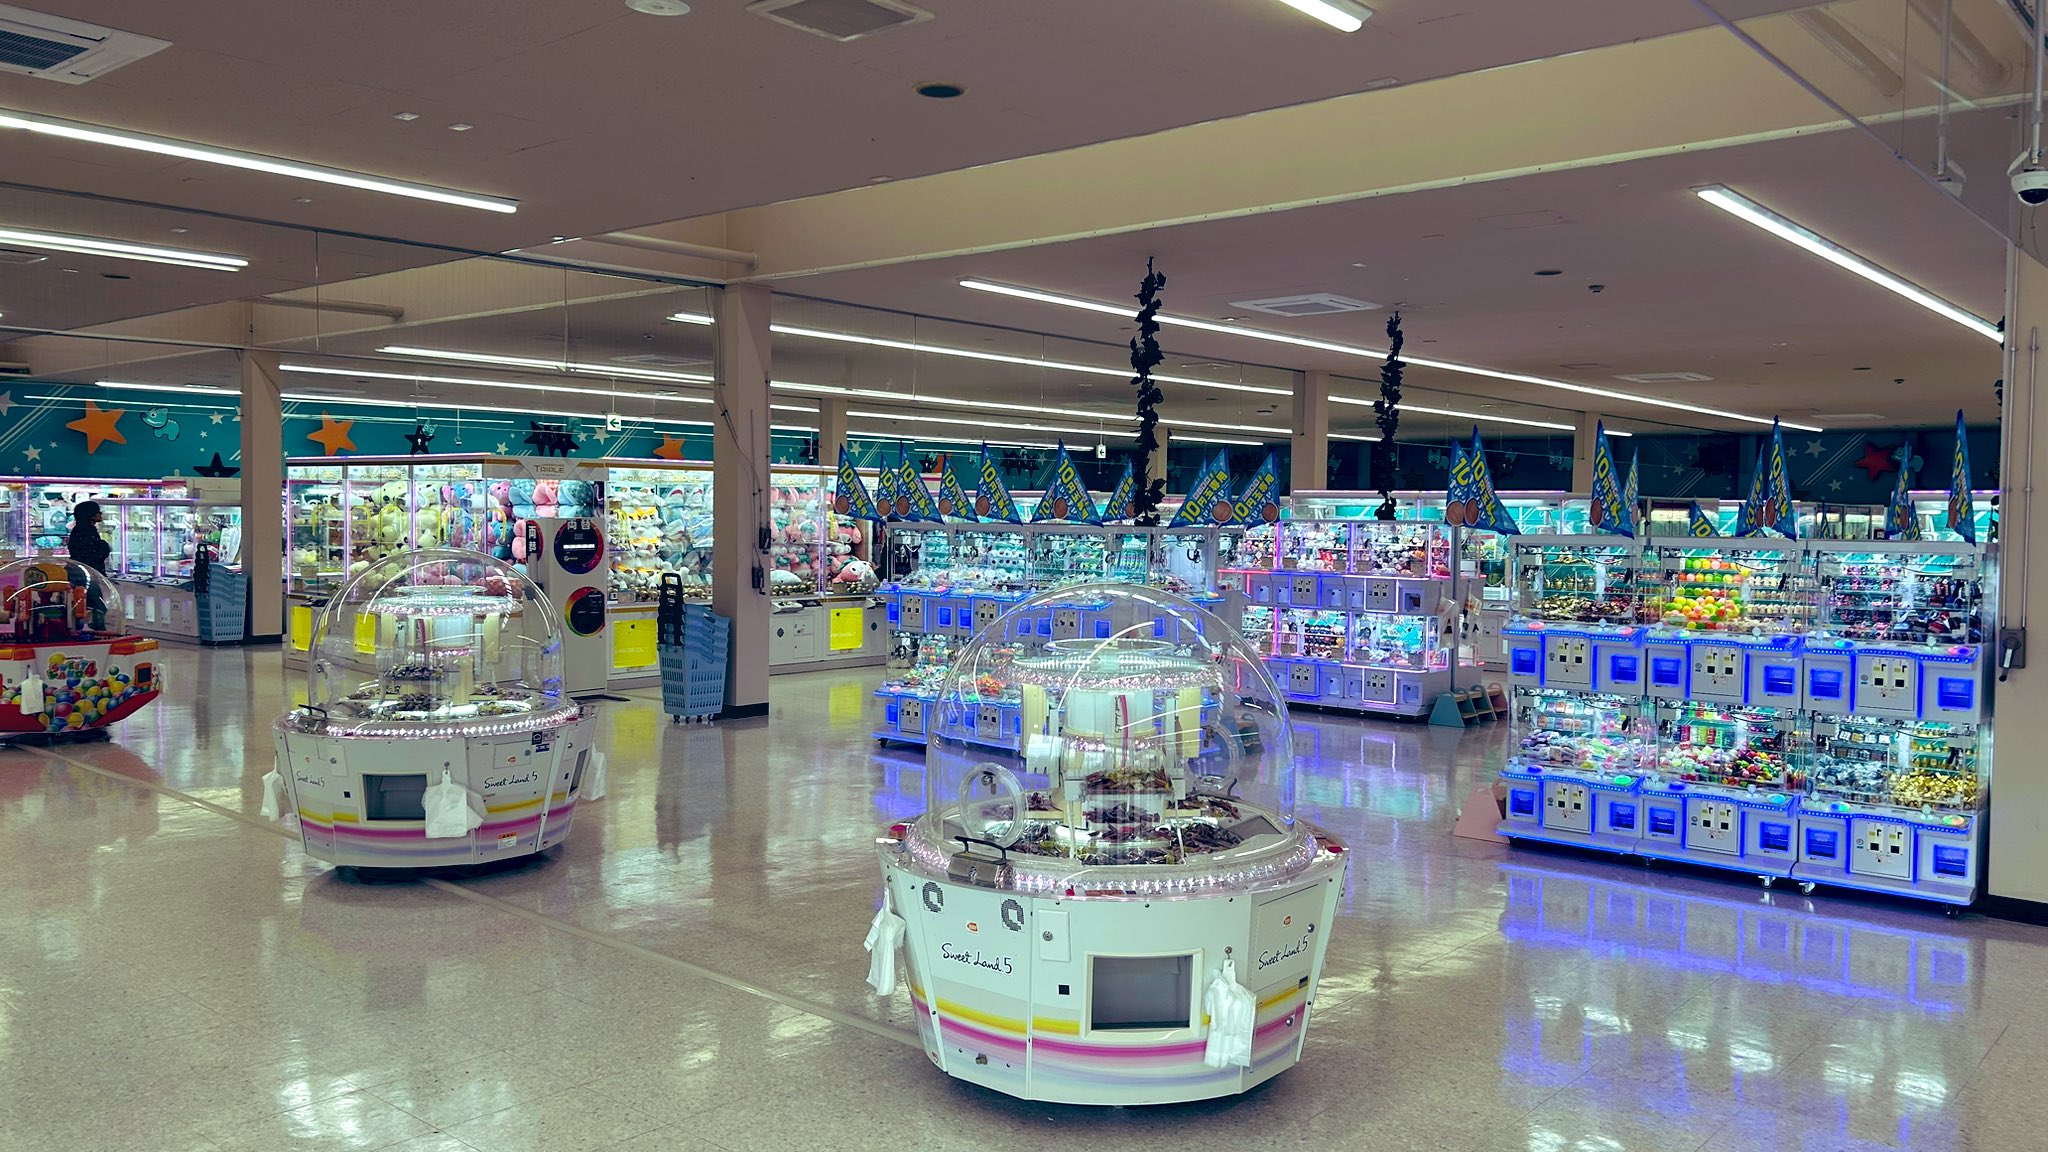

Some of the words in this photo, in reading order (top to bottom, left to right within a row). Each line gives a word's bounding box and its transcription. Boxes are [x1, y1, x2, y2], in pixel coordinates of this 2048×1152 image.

[1691, 516, 1712, 537] 10
[484, 777, 508, 789] Sweet
[532, 770, 538, 782] 5
[941, 942, 973, 965] Sweet
[973, 951, 1002, 972] Land
[1003, 957, 1013, 974] 5
[1258, 950, 1281, 971] Sweet
[1302, 934, 1308, 952] 5
